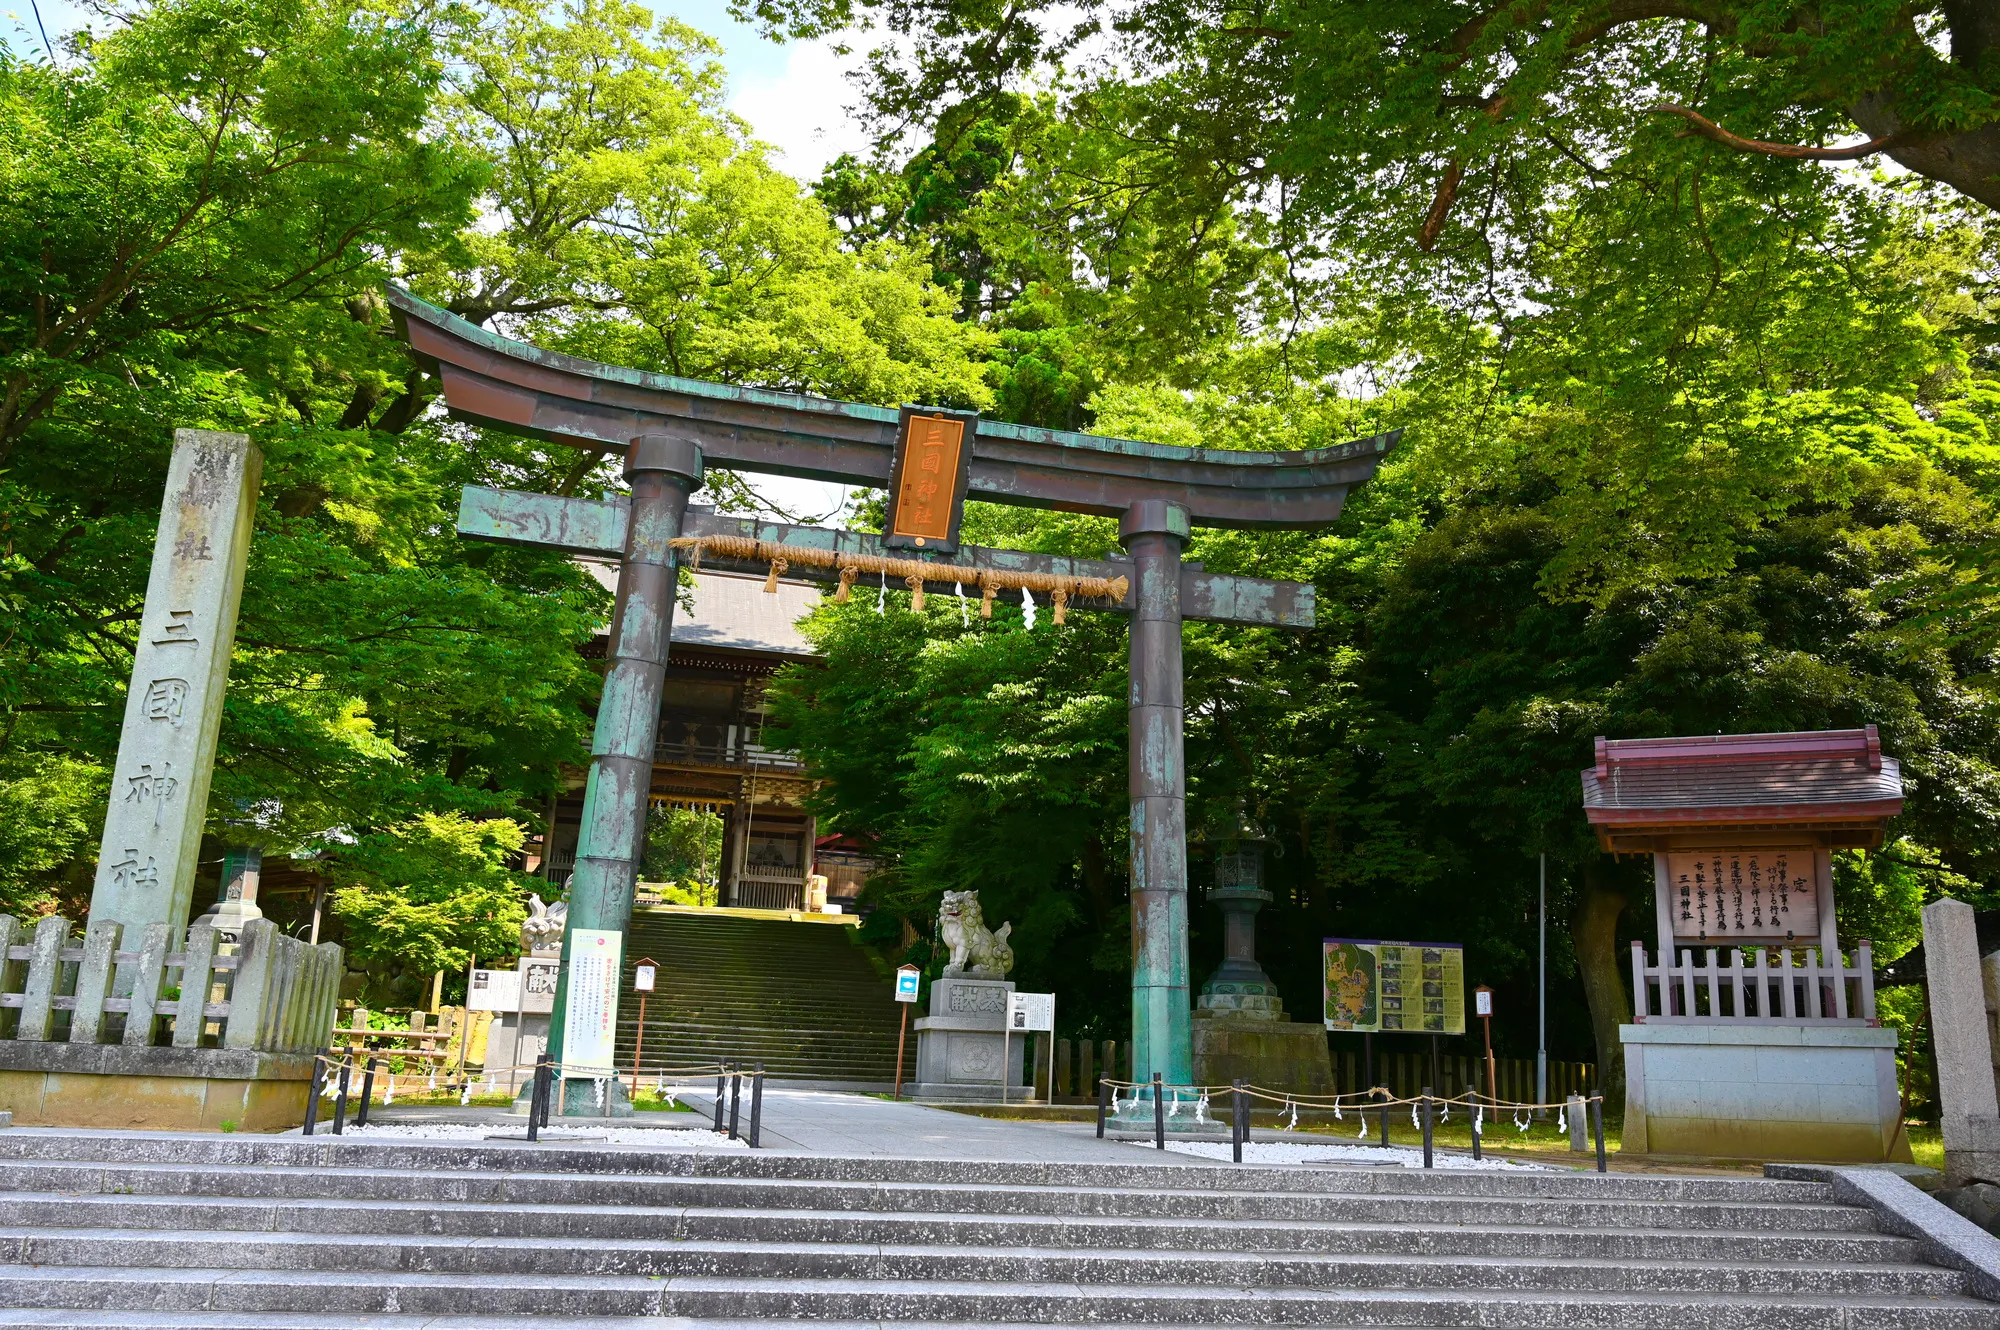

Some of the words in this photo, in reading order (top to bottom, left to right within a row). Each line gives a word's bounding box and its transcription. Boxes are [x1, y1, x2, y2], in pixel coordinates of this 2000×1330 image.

[914, 429, 945, 524] 三國神社
[1678, 874, 1694, 921] 三國神社
[1793, 877, 1808, 893] 定
